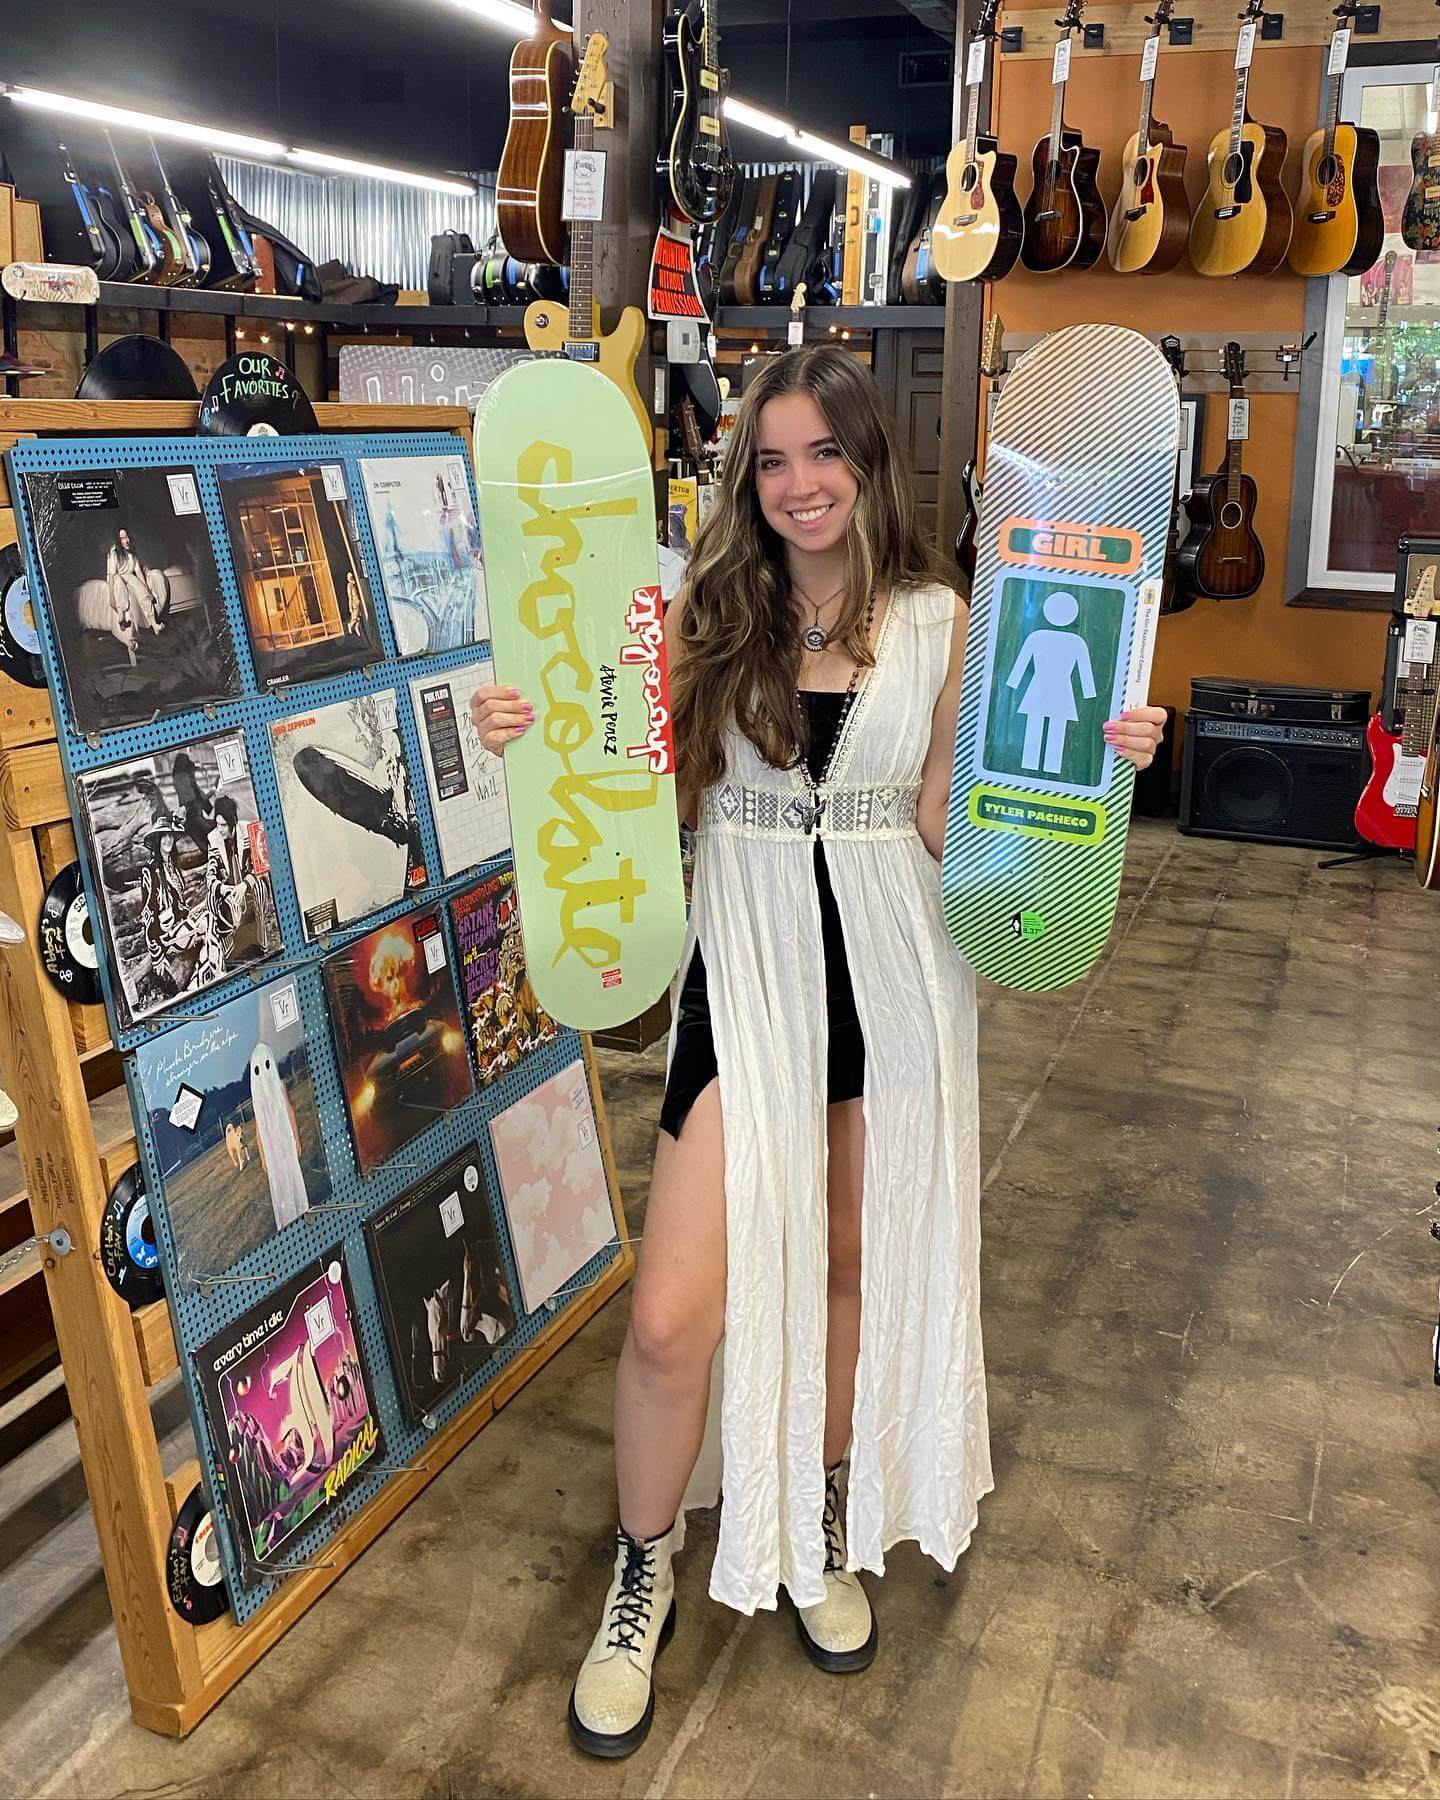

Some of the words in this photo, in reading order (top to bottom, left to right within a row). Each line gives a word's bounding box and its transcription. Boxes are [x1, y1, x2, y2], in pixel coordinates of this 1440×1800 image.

[652, 288, 704, 317] PERMISSION
[239, 357, 272, 377] OUR
[220, 373, 289, 404] FAVORITES
[380, 481, 402, 489] COMPUTER
[1032, 532, 1108, 561] GIRL
[1139, 629, 1148, 659] Skateboard
[1135, 659, 1144, 683] Company
[287, 717, 316, 732] ZEPPELIN
[223, 753, 236, 769] Vr
[473, 775, 499, 801] WALL
[984, 802, 1025, 819] TYLER
[1027, 810, 1089, 828] PACHECO
[279, 1000, 289, 1015] Vr
[213, 1342, 243, 1371] every
[242, 1325, 265, 1348] time
[268, 1310, 284, 1328] die
[324, 1419, 379, 1504] RADICAL
